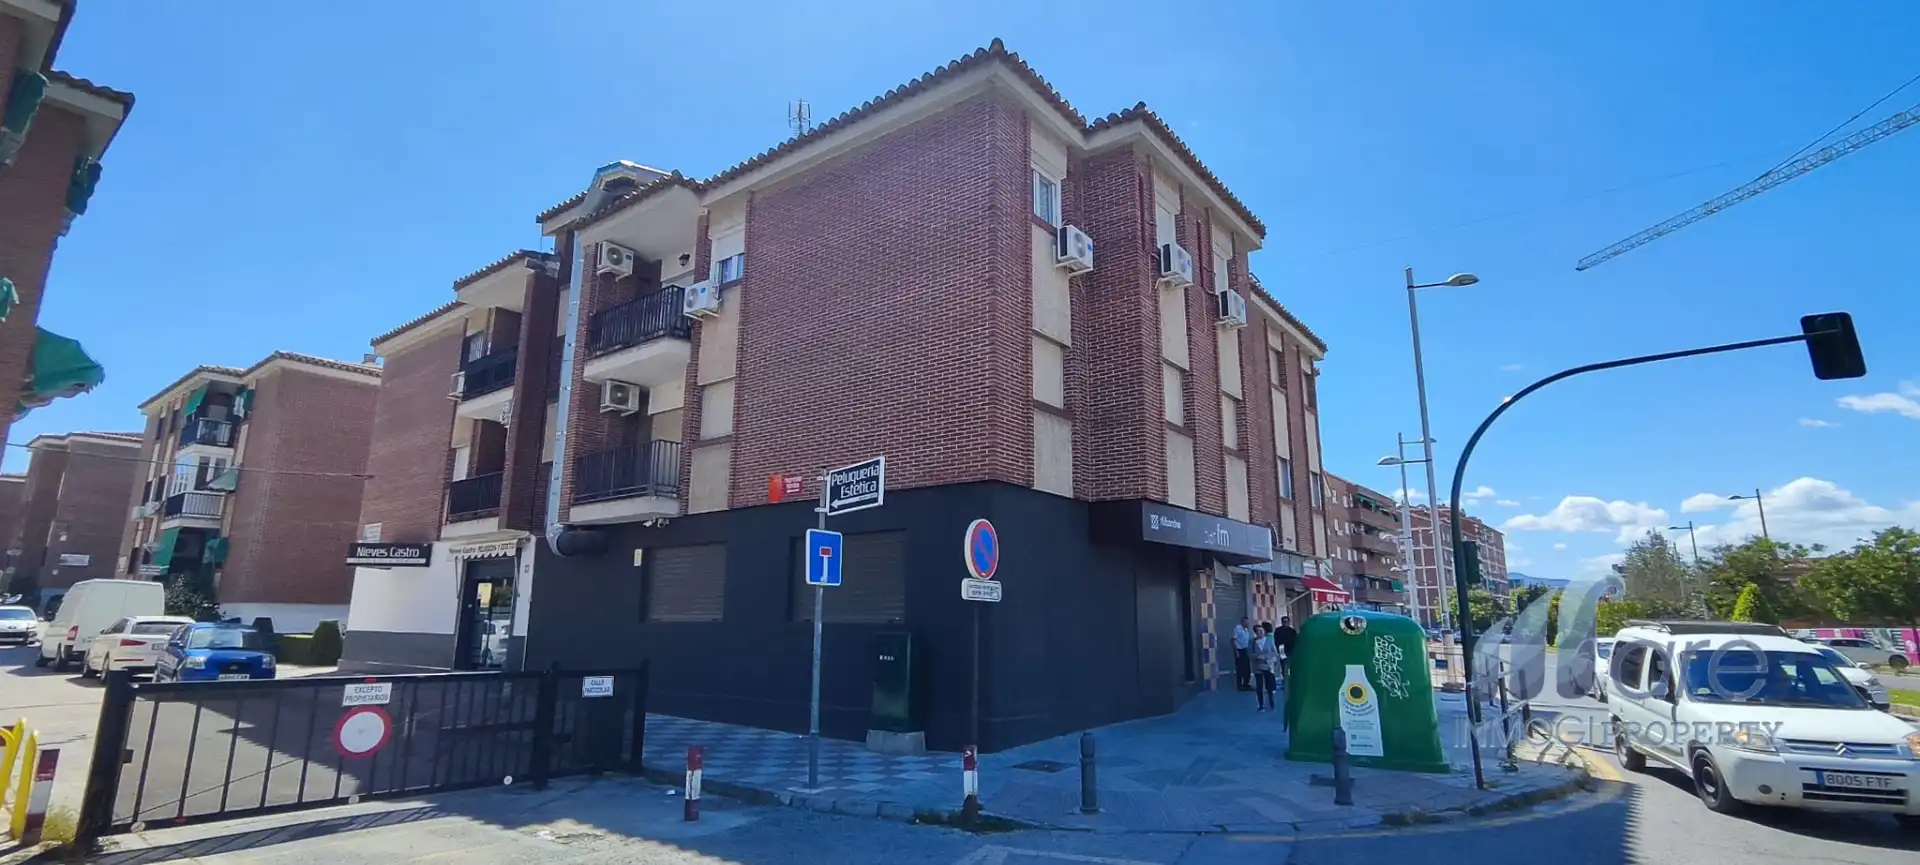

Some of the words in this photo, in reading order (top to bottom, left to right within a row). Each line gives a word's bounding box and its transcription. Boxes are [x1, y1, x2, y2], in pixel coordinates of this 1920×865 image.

[356, 546, 388, 558] Nieves
[389, 546, 420, 558] Castro
[353, 685, 384, 694] EXCEPTO
[344, 694, 390, 703] PROPIETARIOS
